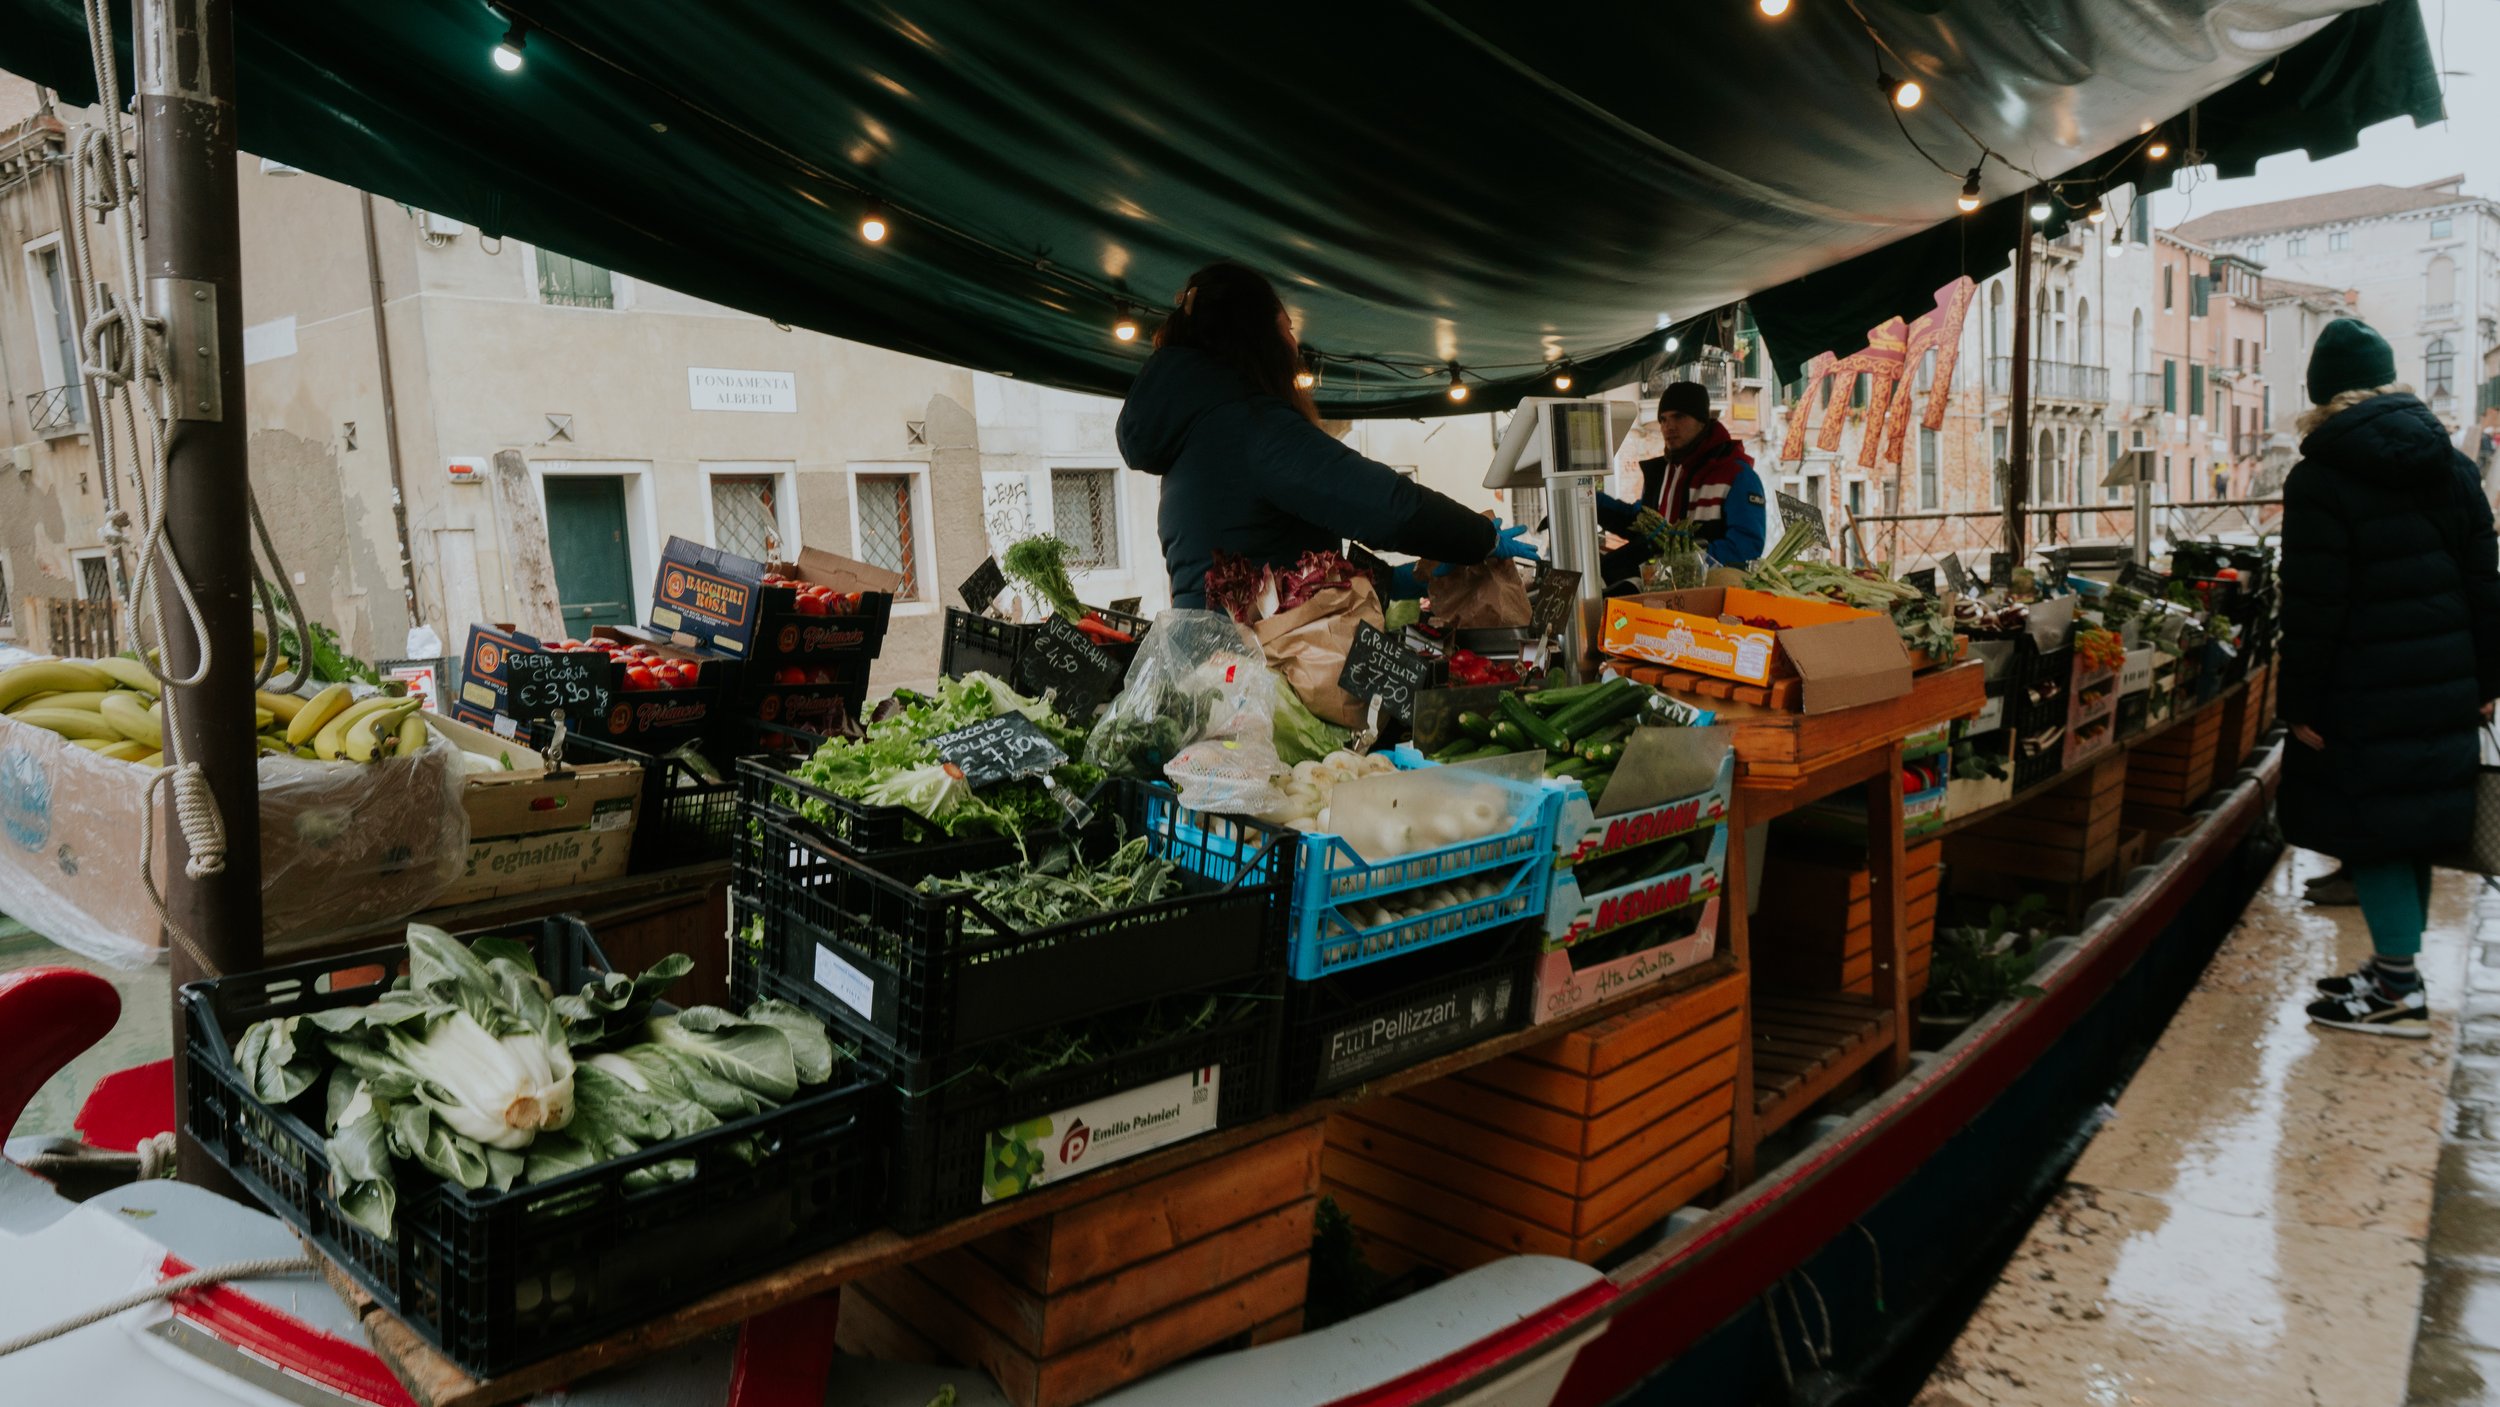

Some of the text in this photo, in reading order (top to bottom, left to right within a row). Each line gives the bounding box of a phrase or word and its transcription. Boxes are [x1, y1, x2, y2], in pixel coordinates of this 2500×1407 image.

[695, 375, 789, 390] FONDAMENTA
[716, 392, 773, 406] ALBERTI
[685, 575, 744, 606] BAGGIERI
[695, 592, 728, 615] ROSA
[1046, 646, 1079, 673] 4,50
[520, 684, 538, 707] €
[544, 681, 590, 706] 3,90
[1602, 799, 1700, 853] MEDIANA
[491, 839, 580, 875] egnathia
[1594, 873, 1692, 933] MEDIANA
[1371, 993, 1458, 1047] Pellizzari
[1092, 1121, 1131, 1142] Emilio
[1132, 1103, 1181, 1130] Palmieri
